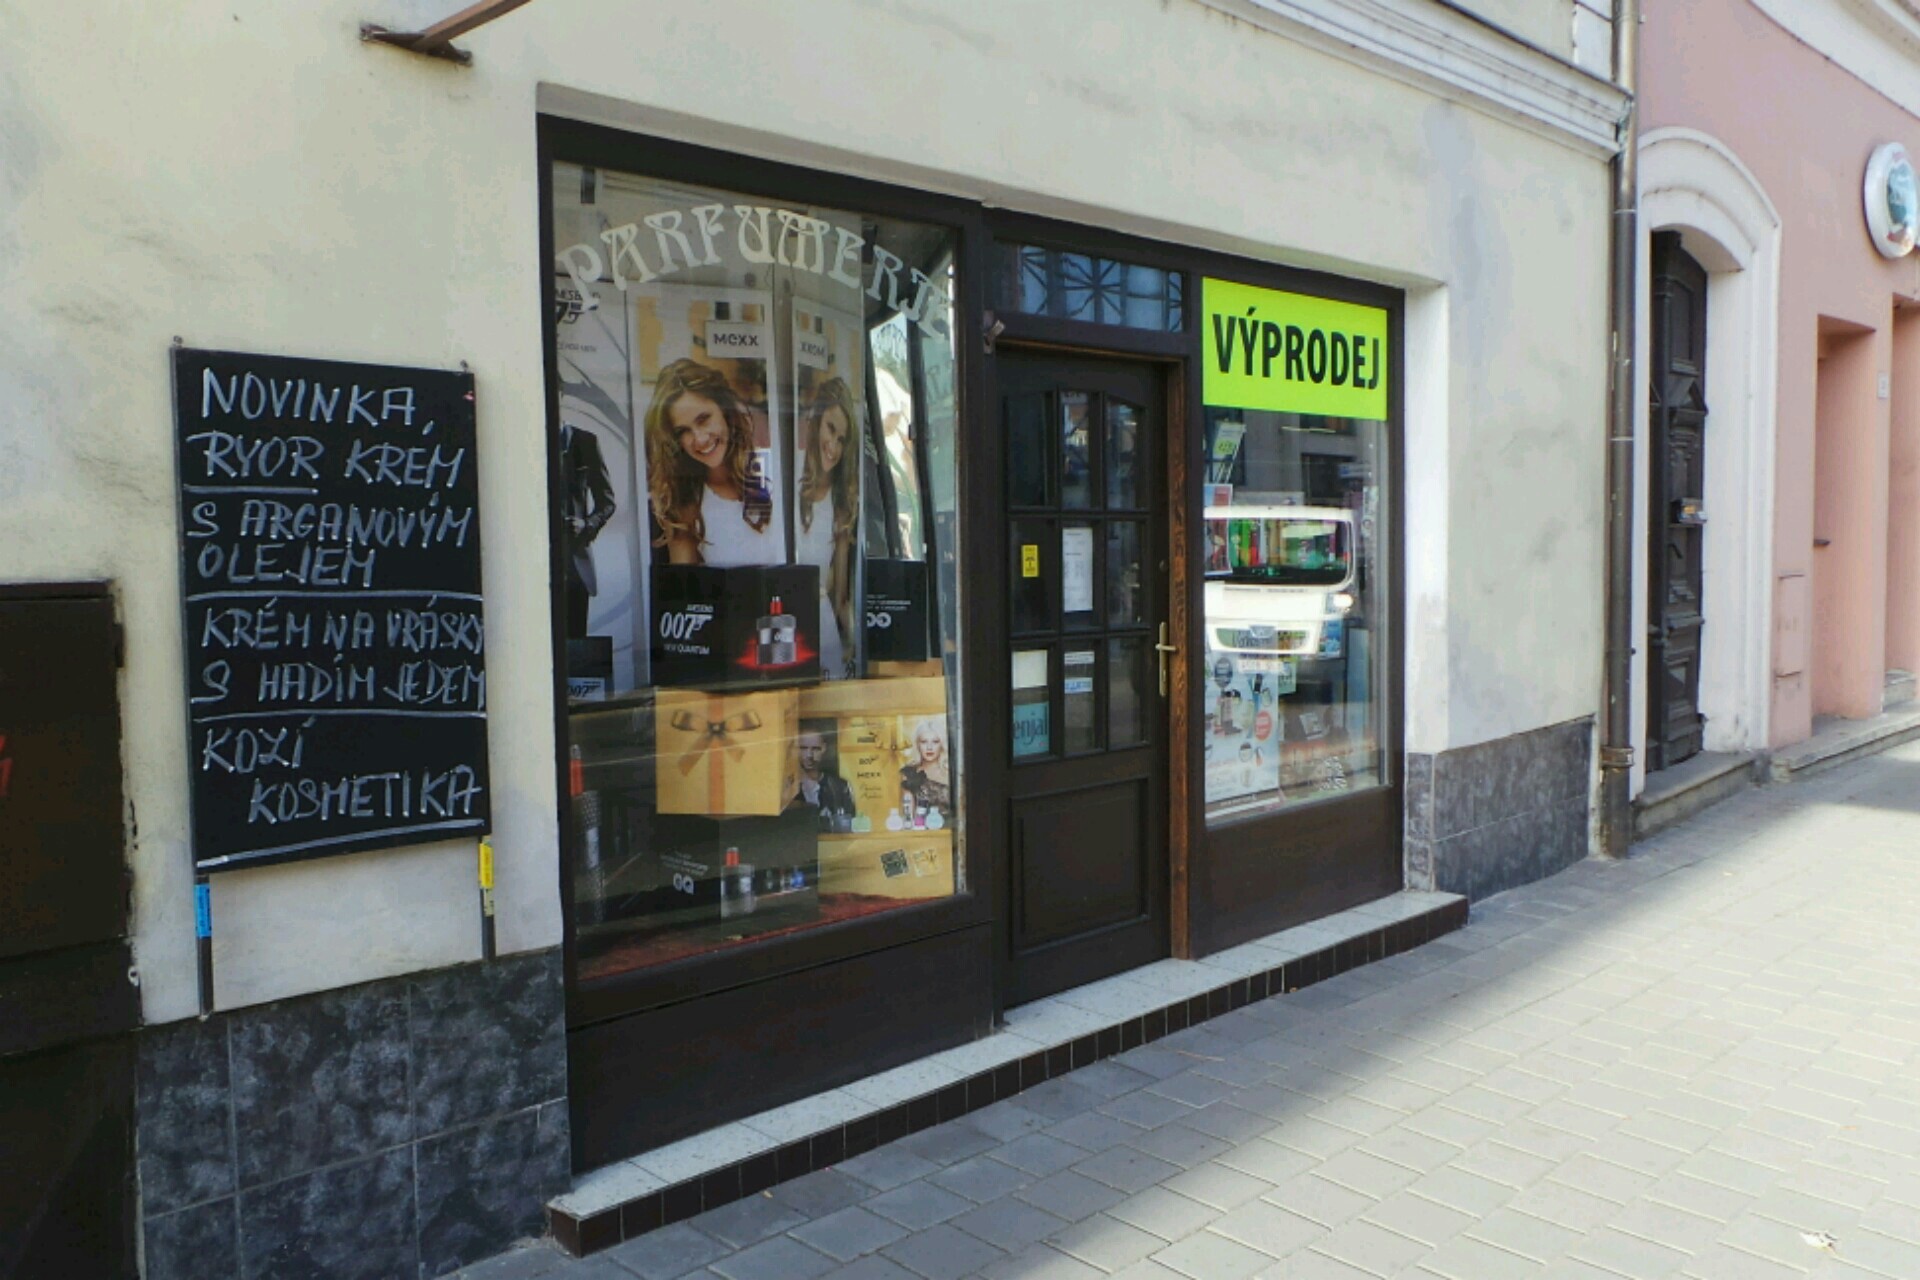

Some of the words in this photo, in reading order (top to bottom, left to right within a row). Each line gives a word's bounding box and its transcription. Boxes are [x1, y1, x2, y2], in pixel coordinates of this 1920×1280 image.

[1212, 307, 1380, 391] VÝPRODEJ
[186, 429, 324, 480] RYOR
[186, 500, 219, 537] S
[239, 491, 472, 549] ARGANOVÝM
[196, 540, 376, 588] OLEJEM
[201, 596, 311, 648] KRÉM
[322, 610, 375, 650] NA
[190, 659, 231, 704] S
[258, 652, 376, 703] HADÍM
[382, 659, 485, 710] JEDEM
[247, 763, 483, 824] KOSMETIKA
